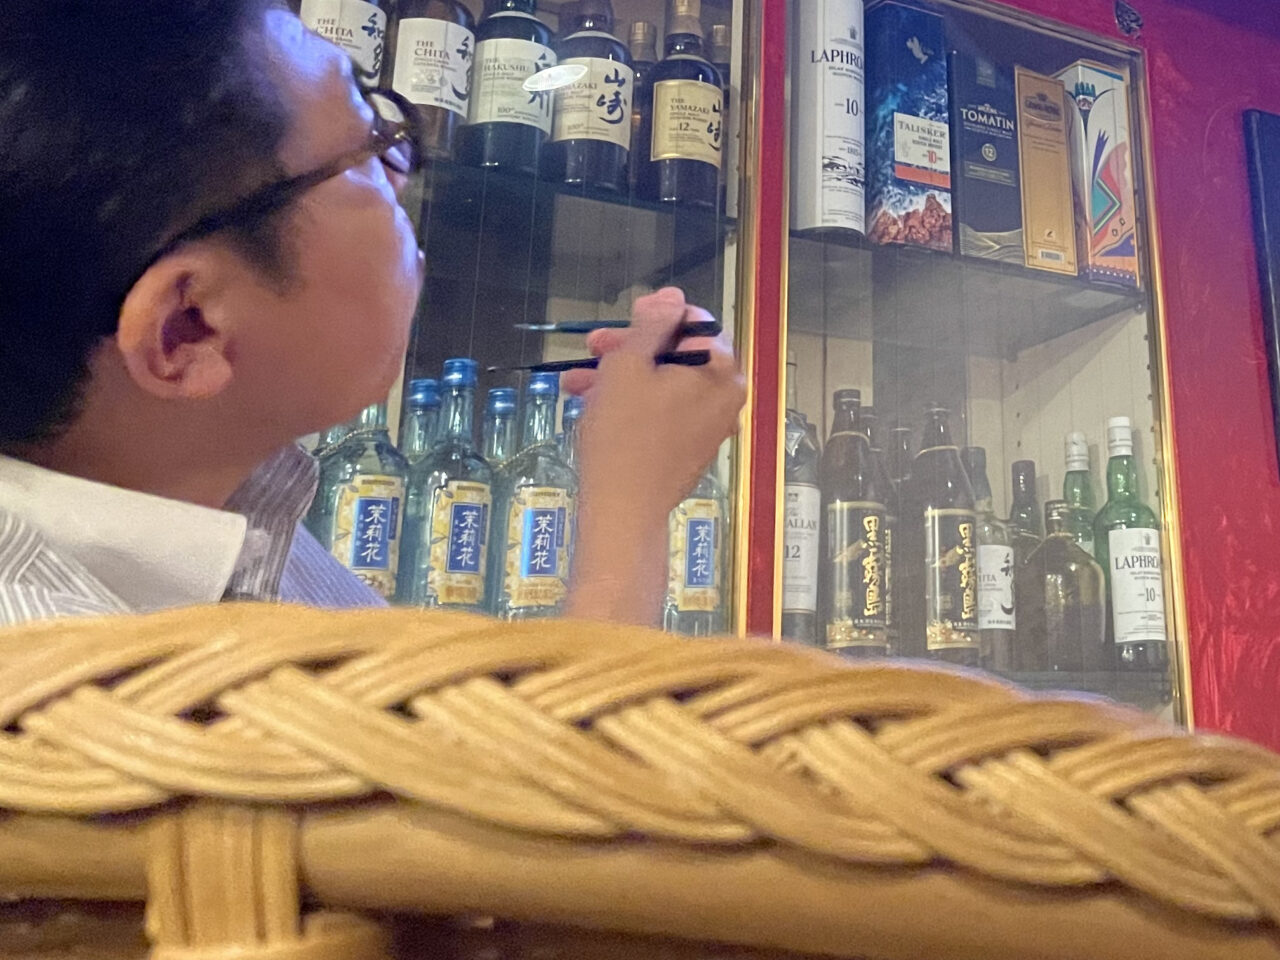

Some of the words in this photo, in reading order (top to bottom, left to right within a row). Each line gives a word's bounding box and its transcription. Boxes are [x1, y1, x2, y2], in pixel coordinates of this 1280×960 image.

[414, 48, 451, 60] CHITA
[898, 120, 946, 139] TALISKER
[960, 107, 1015, 131] TOMATIN
[361, 503, 387, 563] 茉莉花
[456, 510, 479, 568] 茉莉花
[530, 514, 554, 571] 茉莉花
[691, 524, 711, 577] 茉莉花
